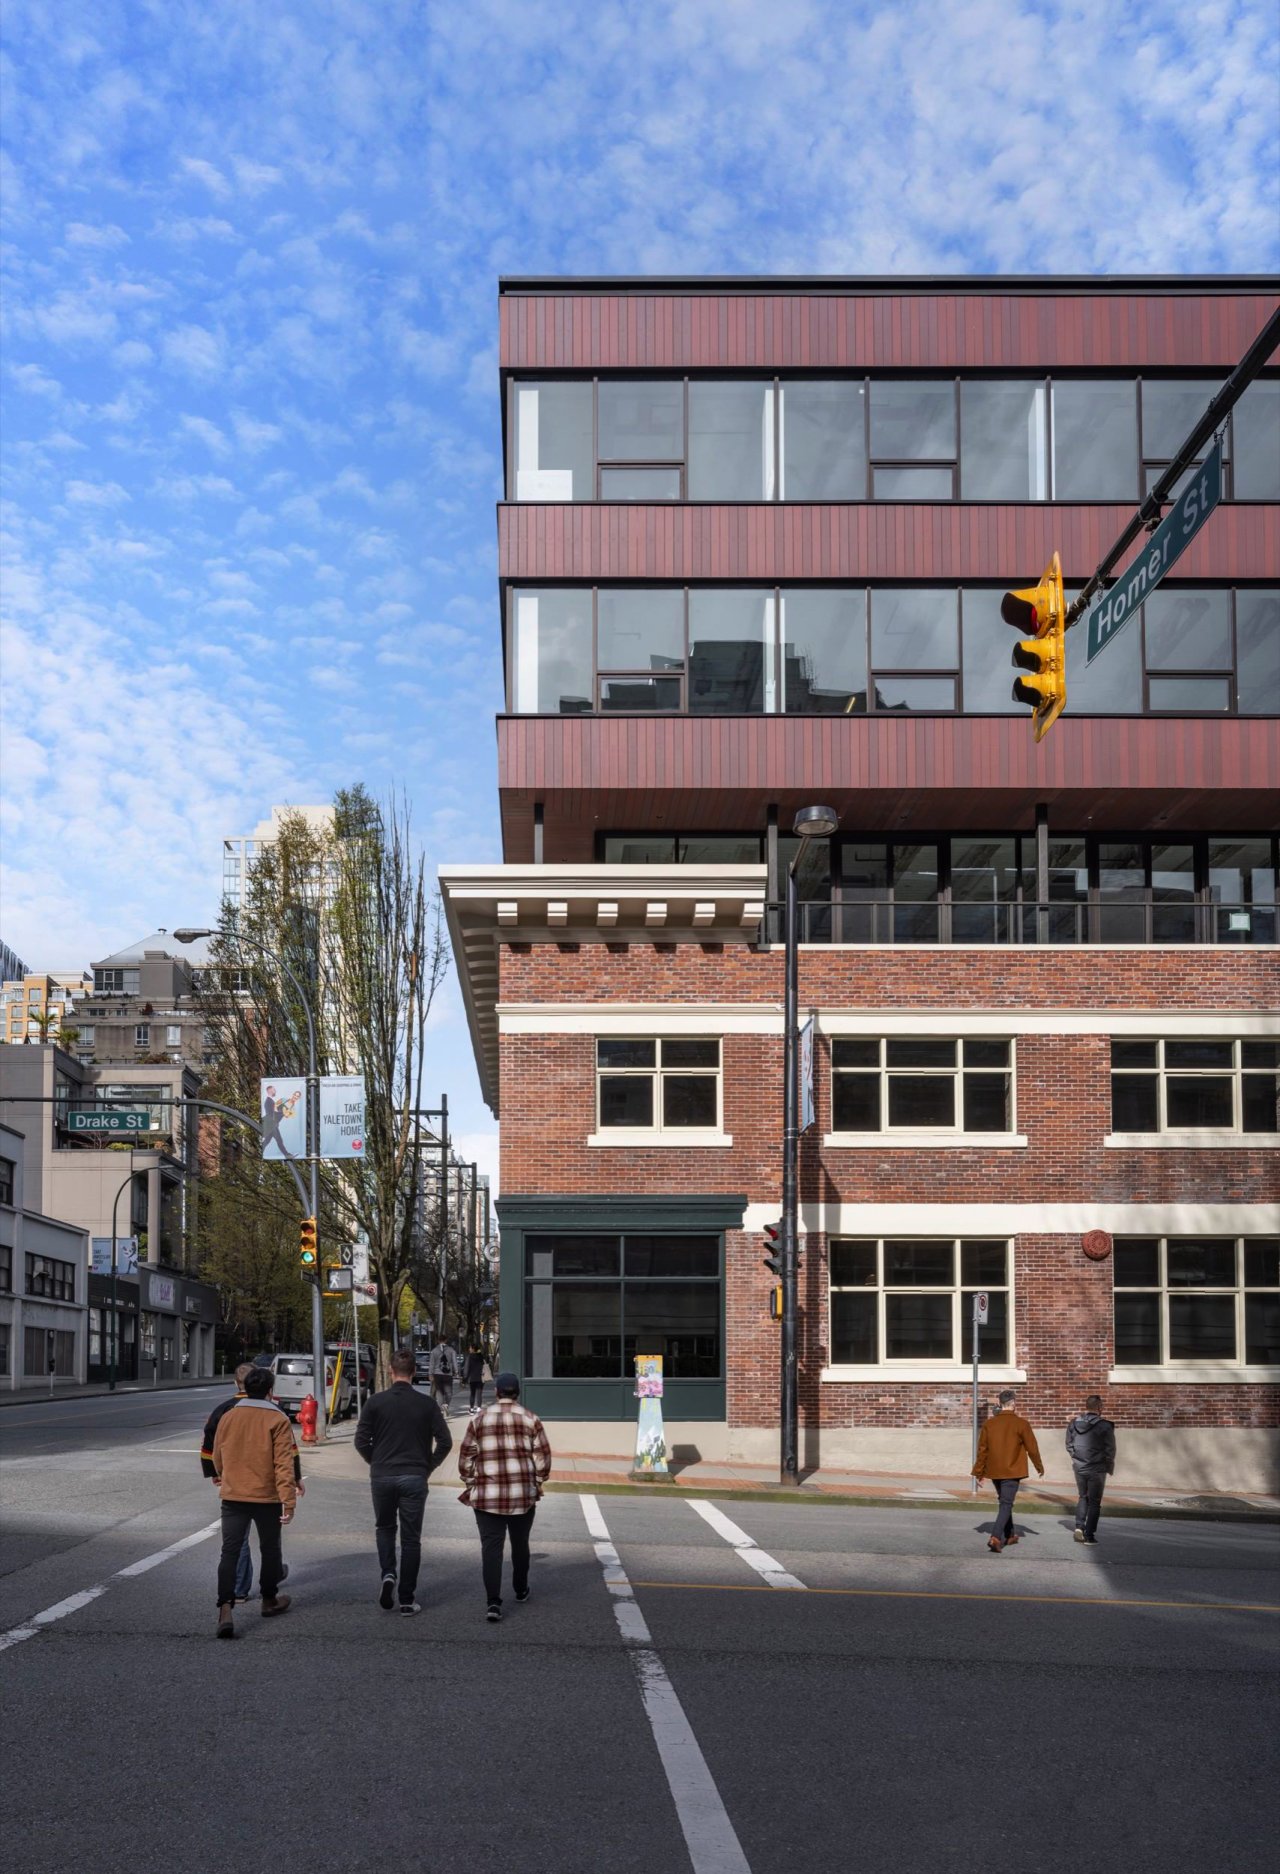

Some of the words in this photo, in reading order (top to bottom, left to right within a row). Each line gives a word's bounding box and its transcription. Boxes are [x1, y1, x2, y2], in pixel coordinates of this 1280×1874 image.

[1096, 533, 1171, 644] Homer
[1182, 473, 1209, 535] St
[344, 1102, 362, 1113] TAKE
[75, 1115, 119, 1128] Drake
[126, 1114, 143, 1128] St
[323, 1114, 362, 1125] YALETOWN
[340, 1125, 362, 1136] HOME
